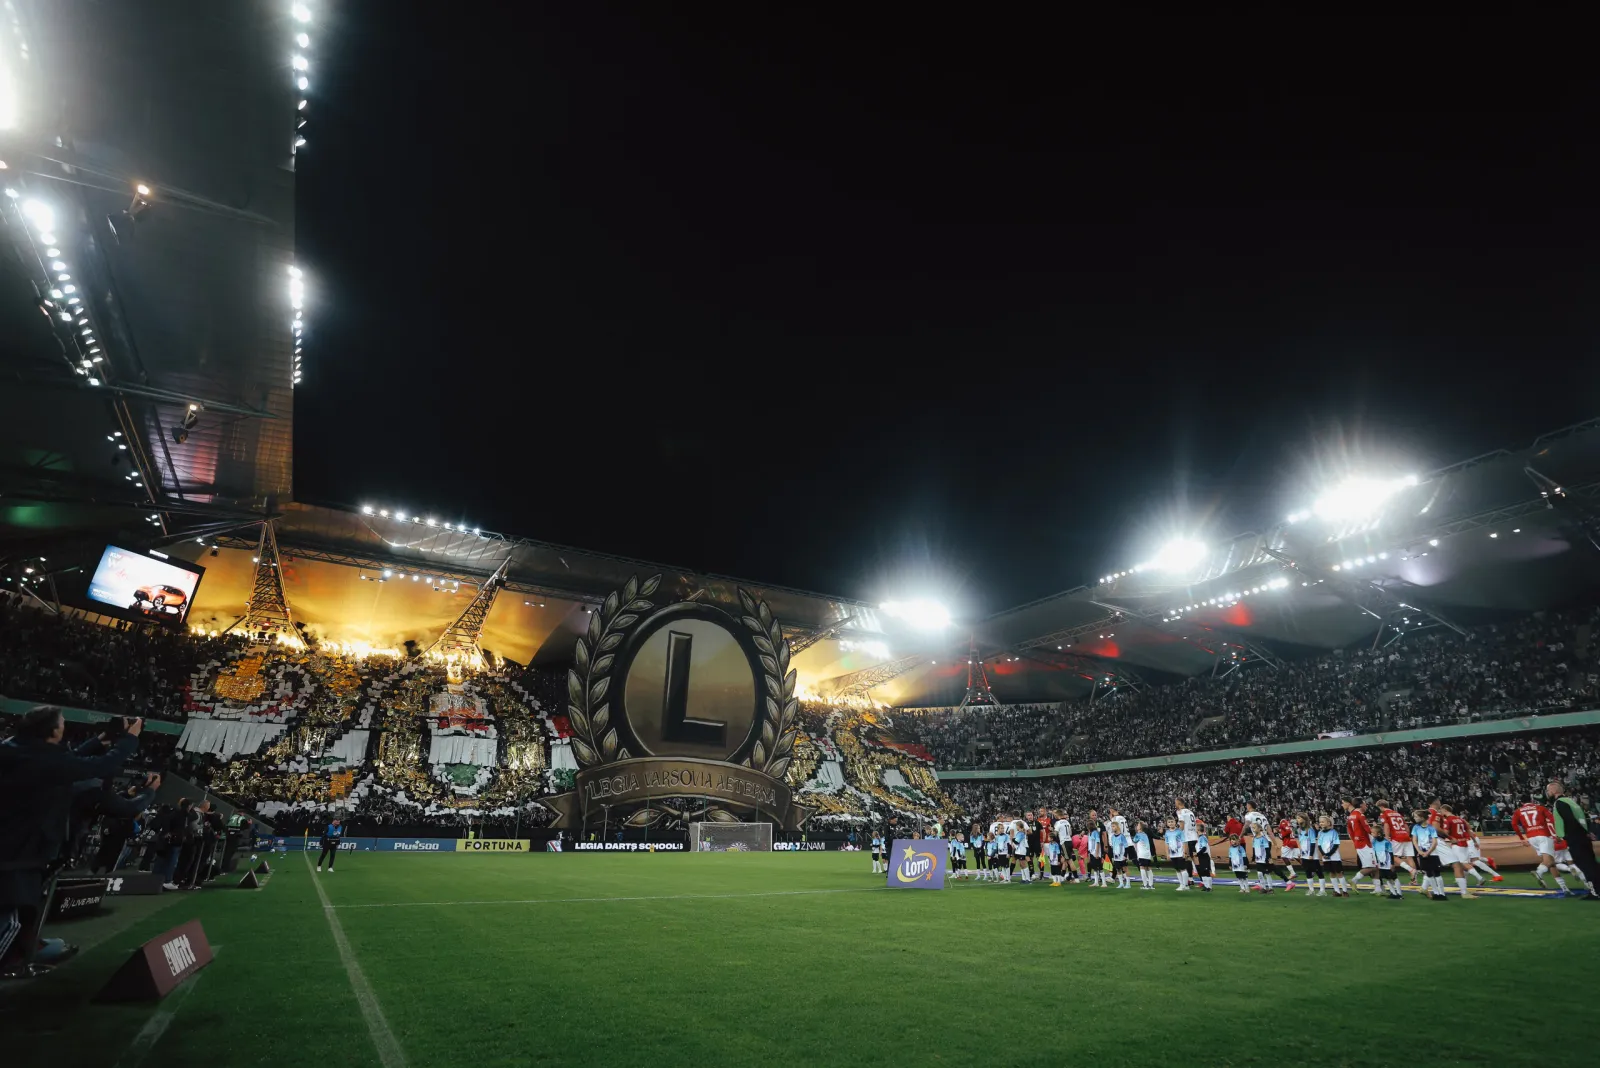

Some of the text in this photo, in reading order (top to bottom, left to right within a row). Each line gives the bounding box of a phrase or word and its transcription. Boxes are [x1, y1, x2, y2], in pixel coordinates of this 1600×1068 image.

[590, 768, 777, 806] LEGIA VARSOVIA AETERNA
[1390, 816, 1406, 831] 52
[1521, 810, 1538, 827] 17
[464, 841, 503, 850] FORTUNA
[575, 842, 683, 850] LEGIA DARTS SCHOOLS
[905, 858, 930, 877] LOTTO
